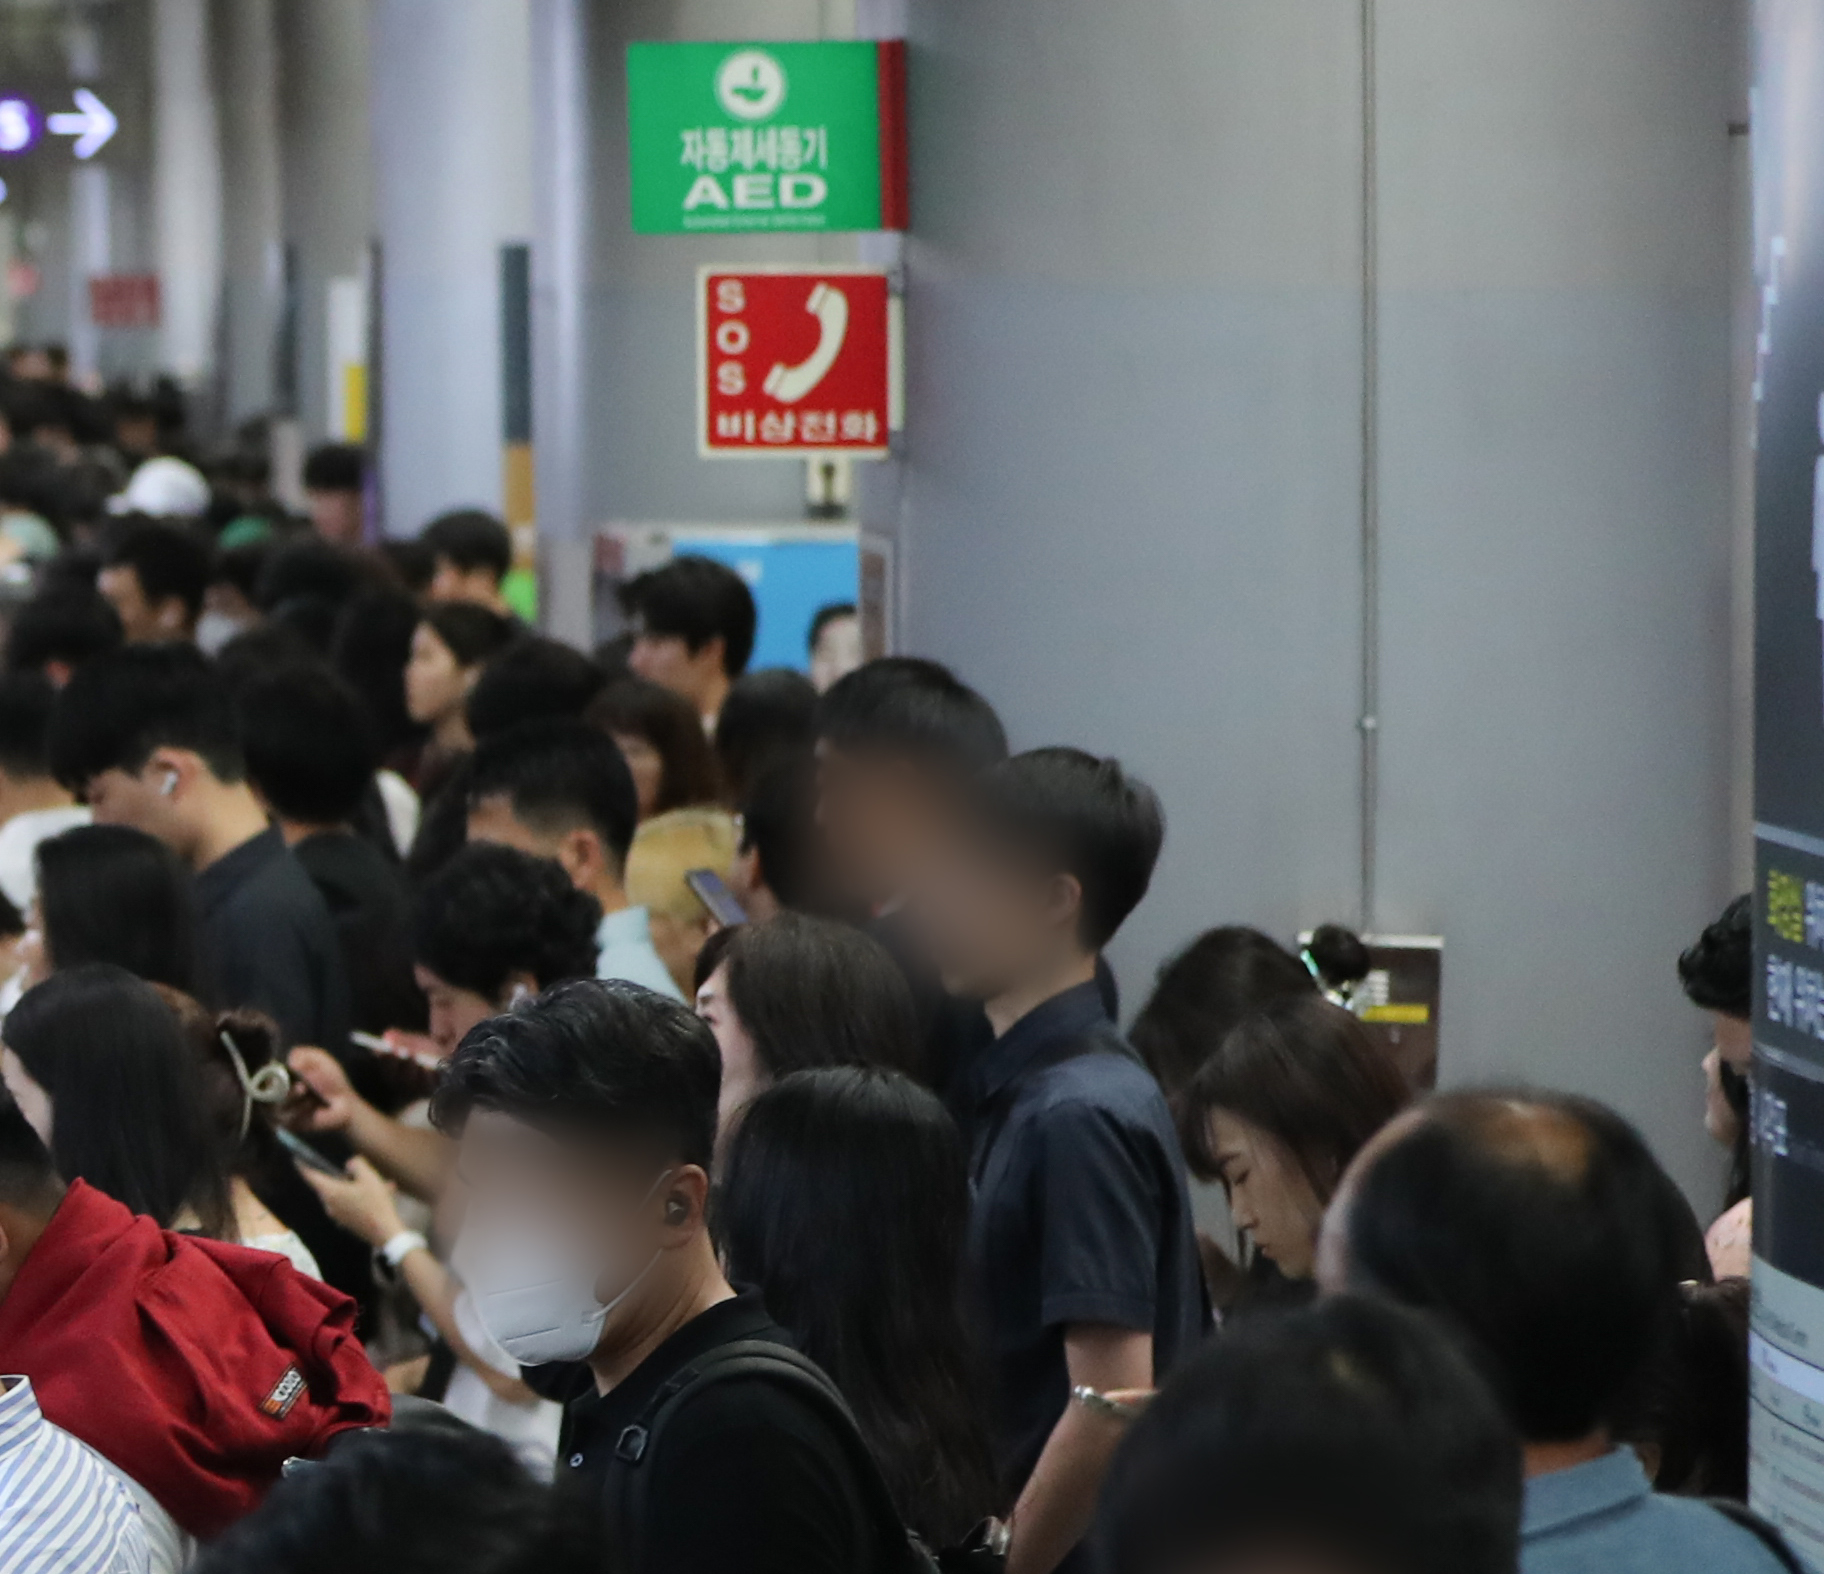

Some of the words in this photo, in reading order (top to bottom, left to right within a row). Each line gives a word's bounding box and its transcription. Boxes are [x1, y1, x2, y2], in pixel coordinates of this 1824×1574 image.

[680, 126, 829, 173] 자동제세동기
[683, 174, 828, 211] AED
[715, 279, 750, 396] SOS
[716, 410, 878, 443] 비상전화
